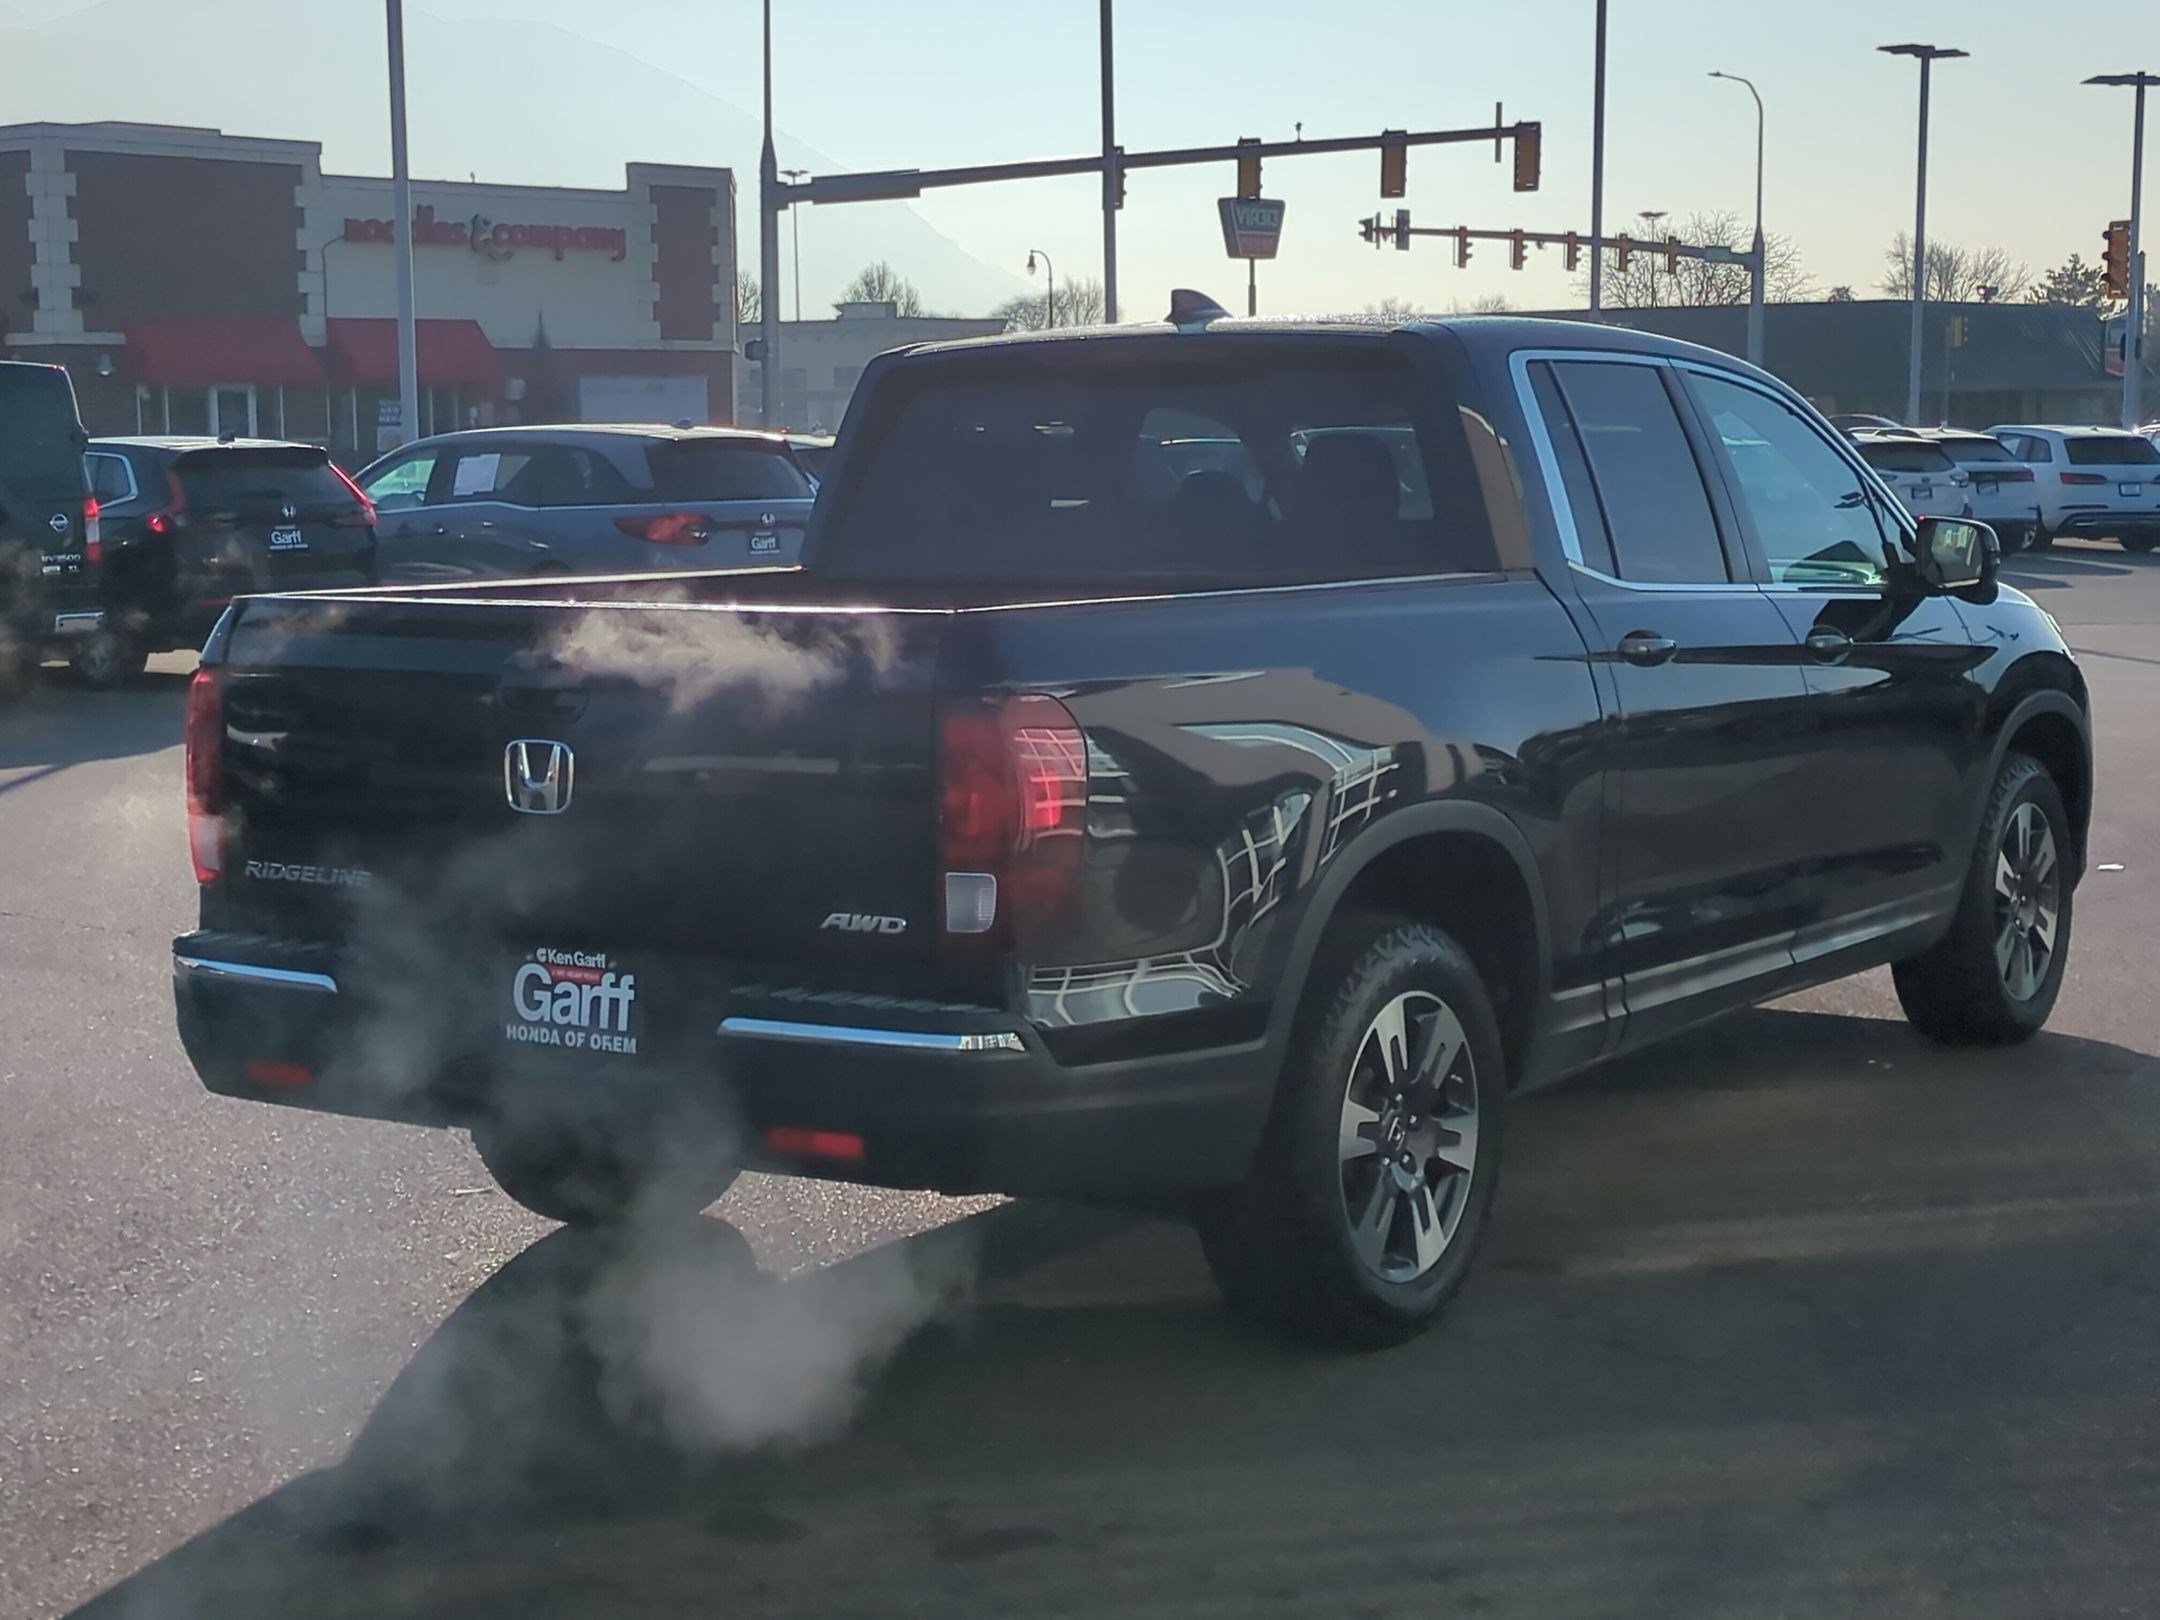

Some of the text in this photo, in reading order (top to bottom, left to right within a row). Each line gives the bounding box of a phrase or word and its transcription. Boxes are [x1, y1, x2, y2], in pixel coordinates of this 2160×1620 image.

[244, 860, 373, 887] RIDGELINE
[820, 913, 907, 934] AWD
[548, 948, 606, 969] Ken Garff
[513, 962, 636, 1032] Garff
[506, 1023, 637, 1055] HONDA OF OREM
